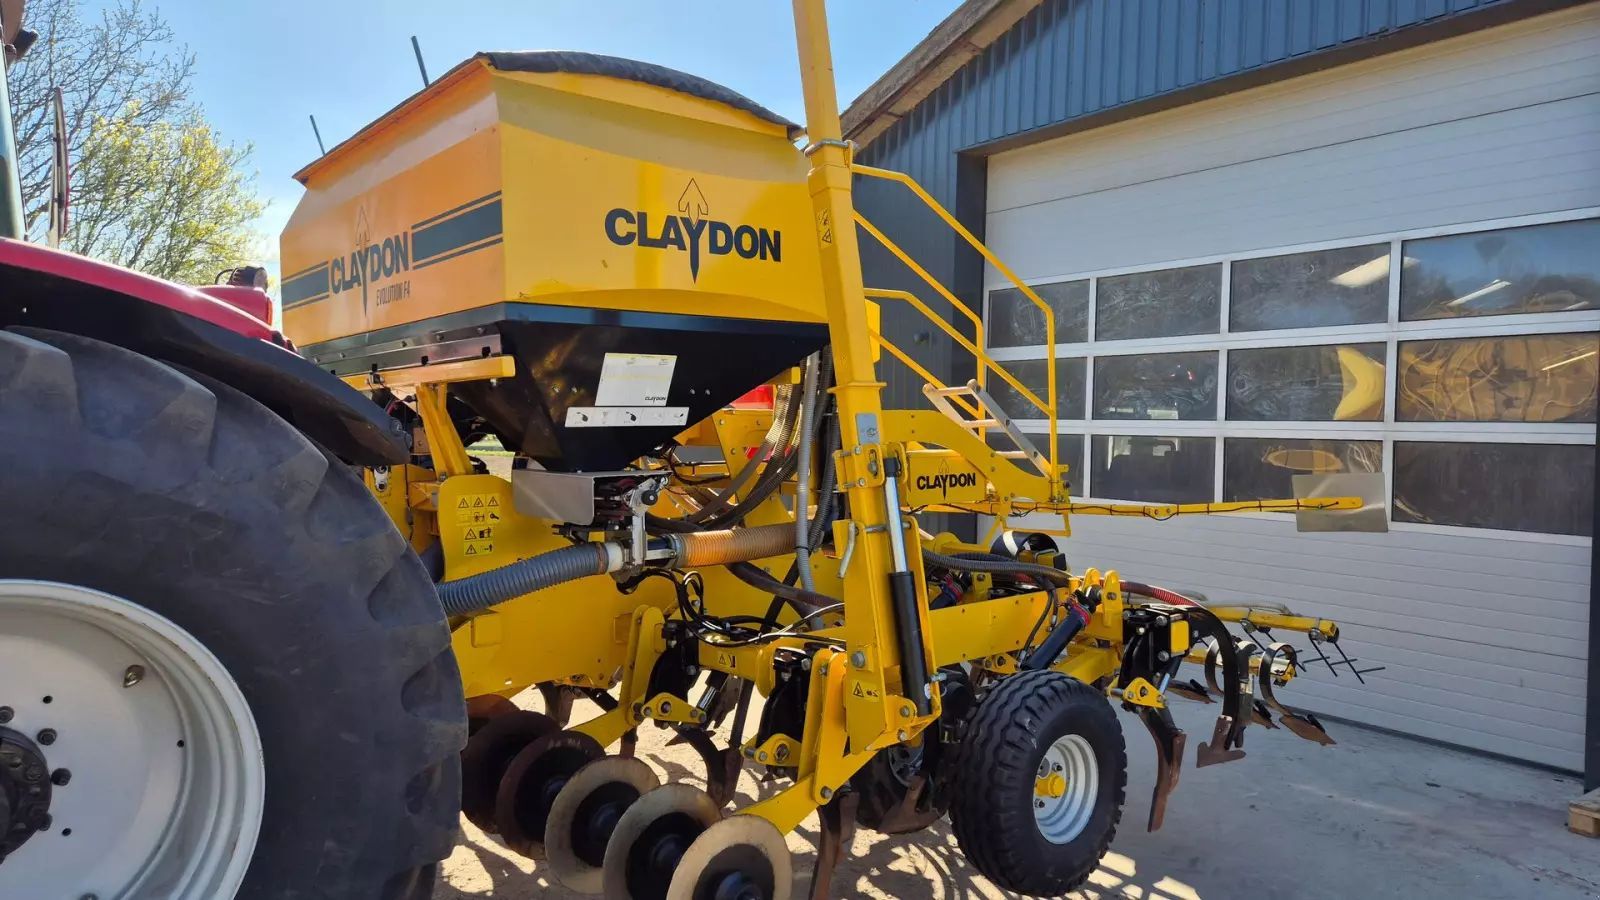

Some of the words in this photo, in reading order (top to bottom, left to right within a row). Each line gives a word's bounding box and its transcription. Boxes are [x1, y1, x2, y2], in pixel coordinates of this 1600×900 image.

[605, 208, 781, 284] CLAYDON
[331, 231, 409, 317] CLAYDON
[376, 282, 402, 306] EVOLUTION
[403, 280, 410, 299] F4
[645, 396, 666, 404] CLAYDON
[917, 473, 976, 500] CLAYDON
